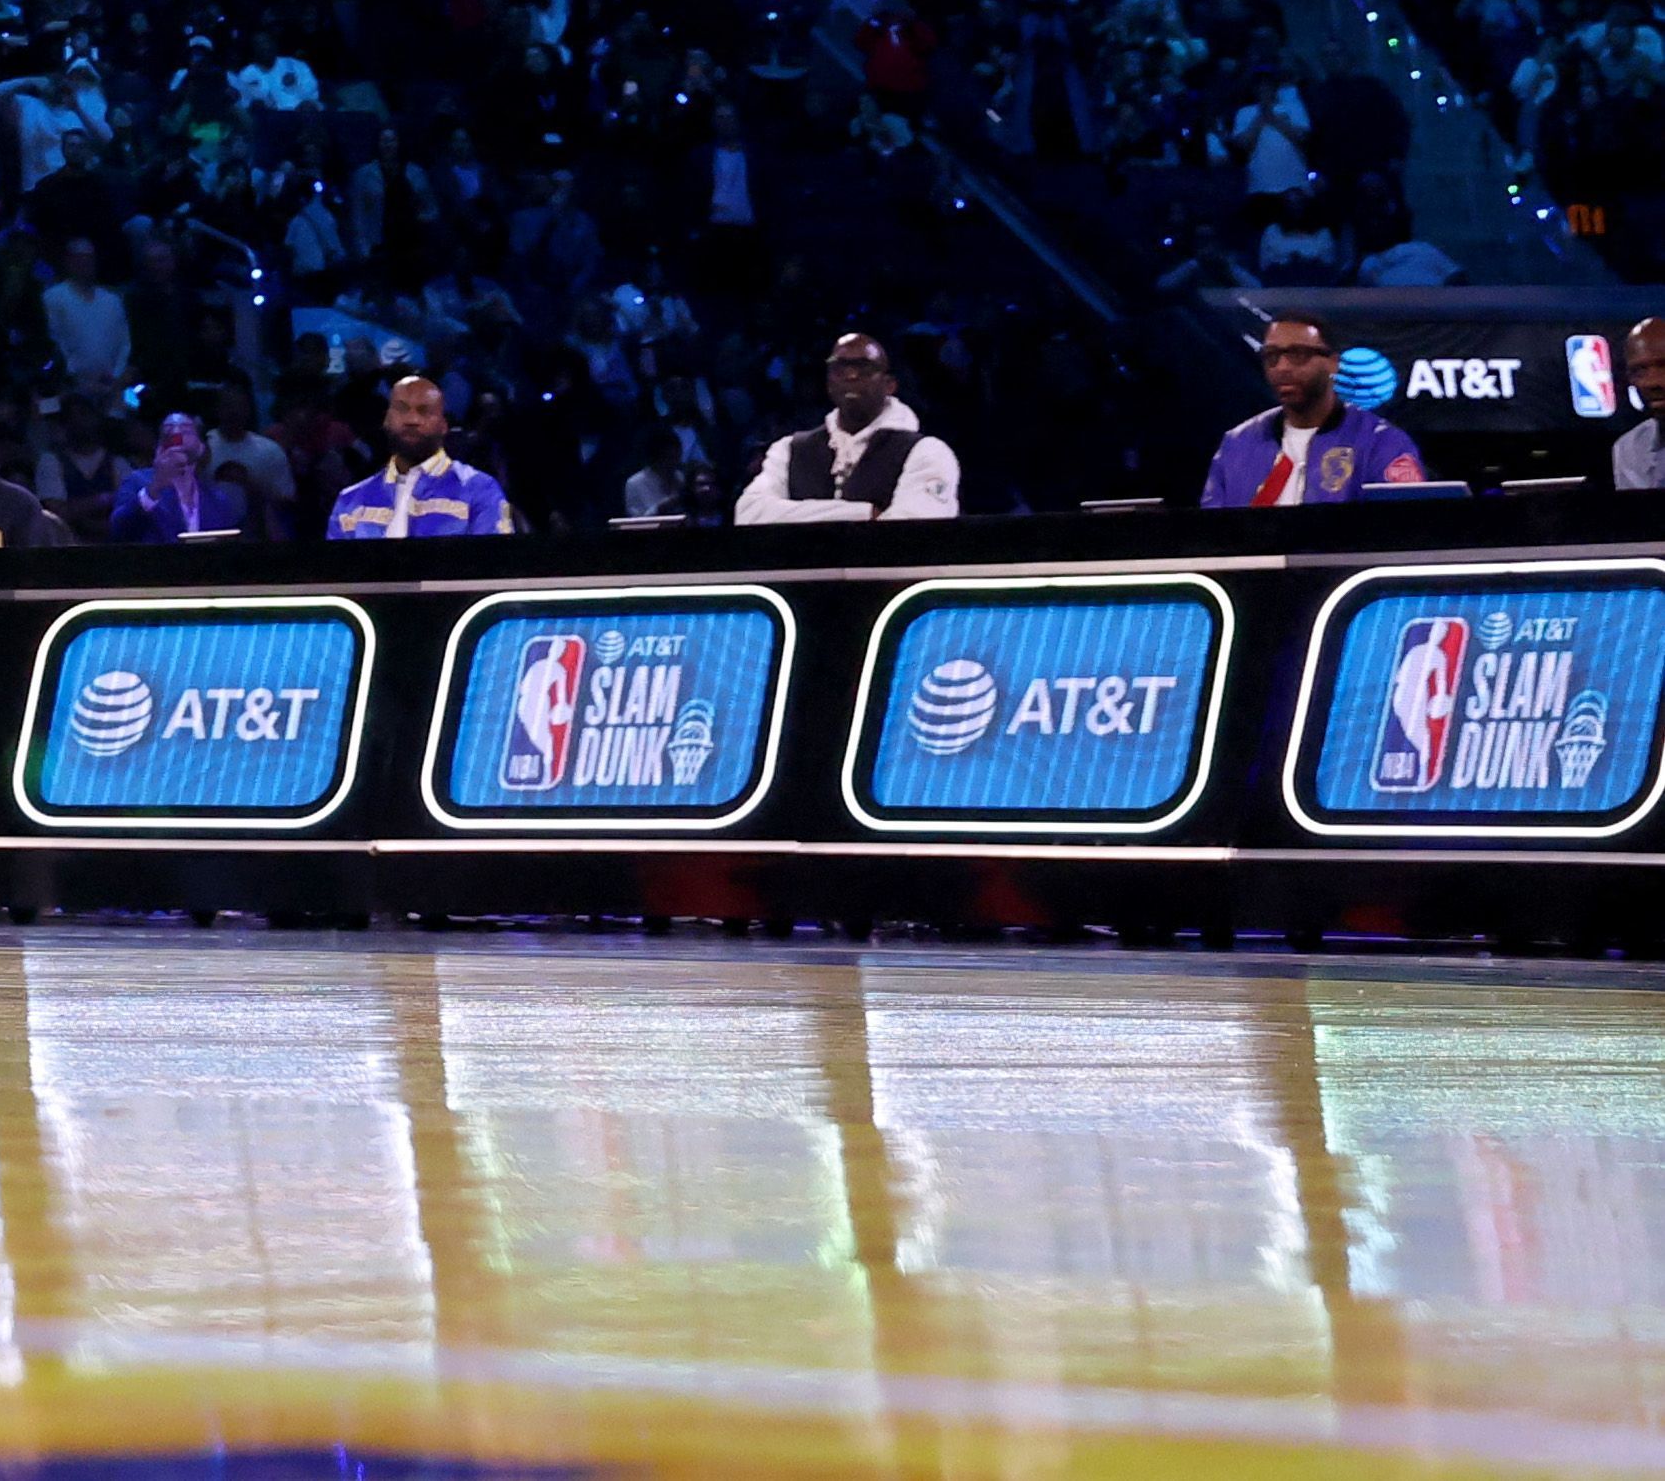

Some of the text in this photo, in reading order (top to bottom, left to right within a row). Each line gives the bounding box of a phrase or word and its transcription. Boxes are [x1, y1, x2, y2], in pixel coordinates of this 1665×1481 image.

[1406, 358, 1522, 400] AT&T
[629, 635, 687, 657] AT&T
[1513, 615, 1579, 642] AT&T
[164, 687, 320, 742] AT&T
[585, 665, 680, 726] SLAM
[1007, 676, 1178, 736] AT&T
[1465, 650, 1573, 721] SLAM
[572, 726, 669, 787] DUNK
[1449, 720, 1561, 790] DUNK
